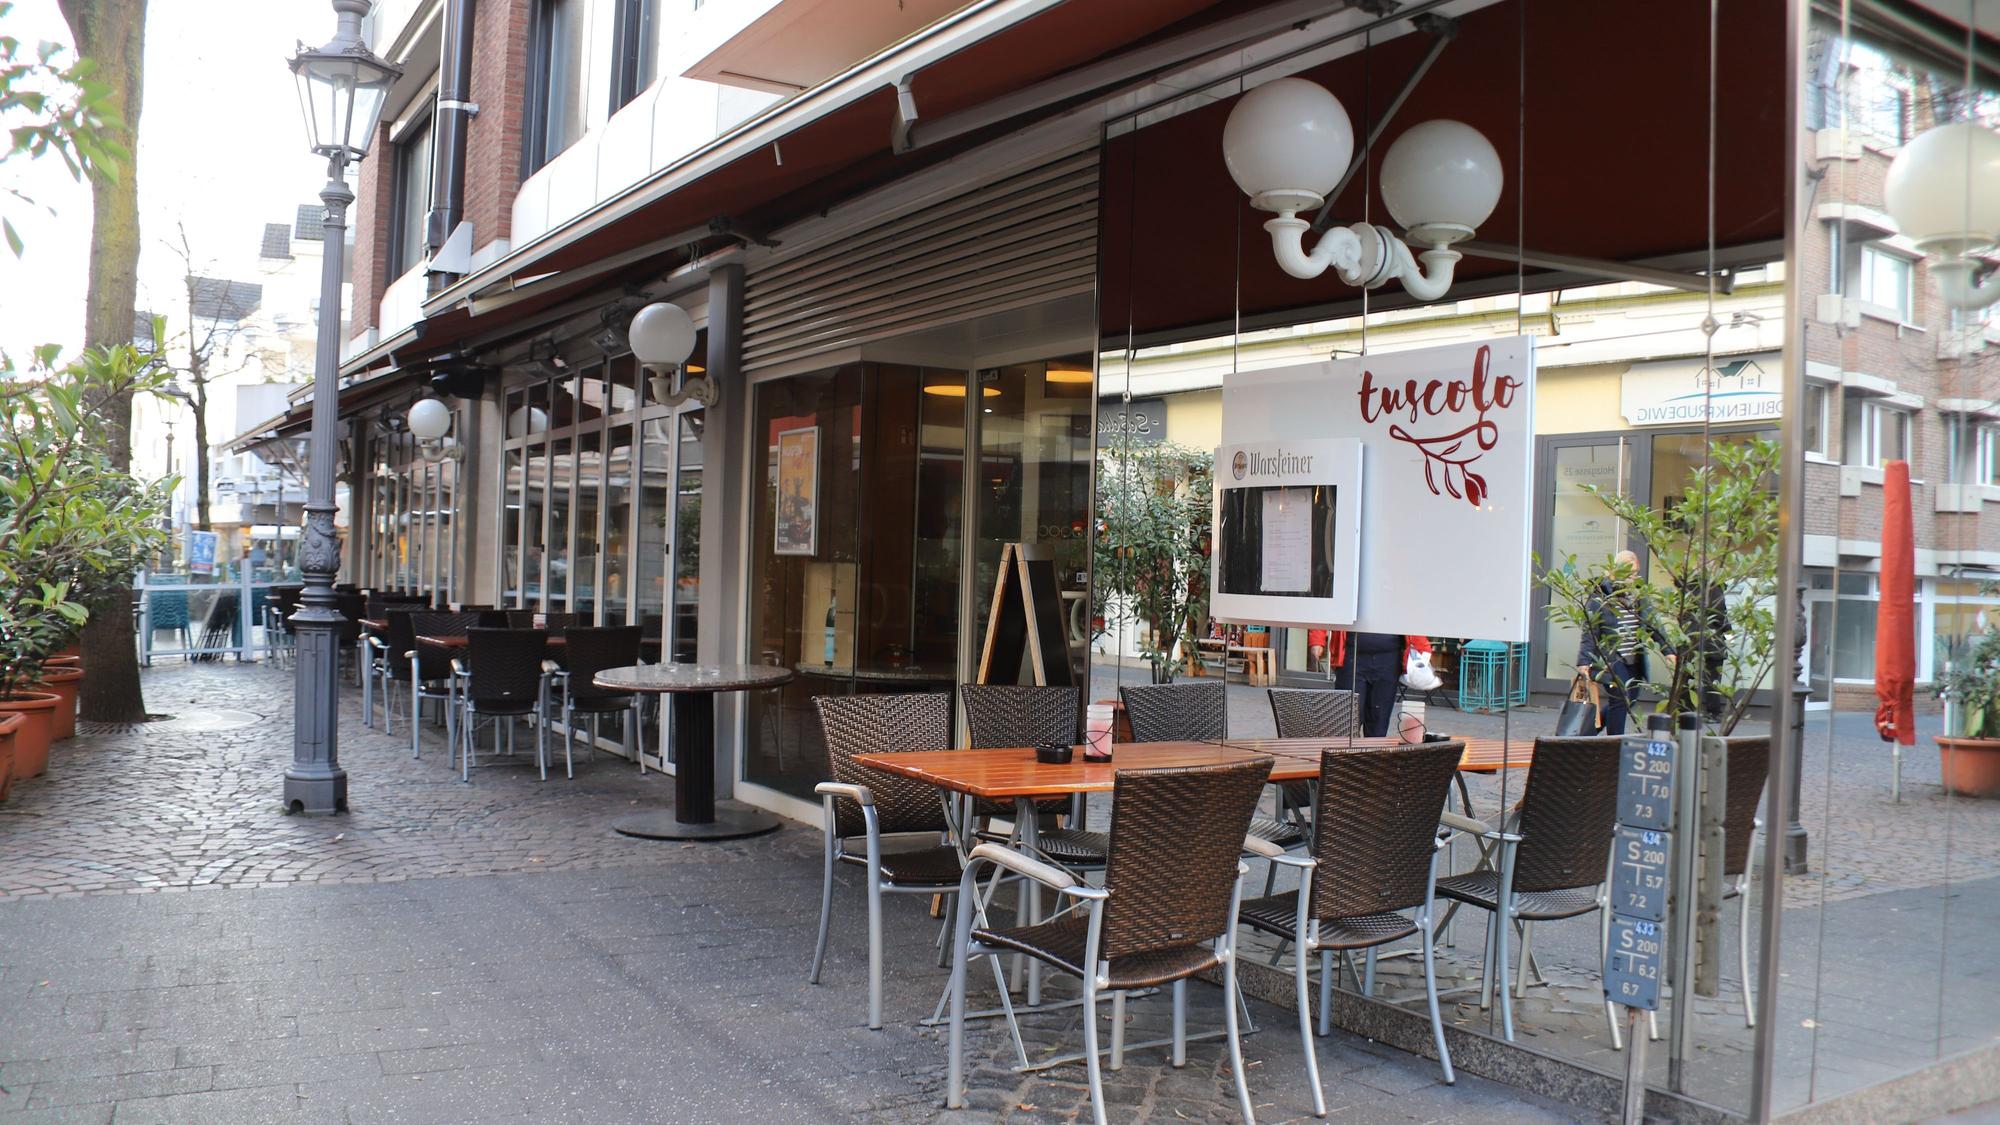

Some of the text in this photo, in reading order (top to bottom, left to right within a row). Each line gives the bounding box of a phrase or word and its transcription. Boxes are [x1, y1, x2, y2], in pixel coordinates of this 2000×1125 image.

[1357, 345, 1524, 424] tuscolo
[1250, 448, 1313, 478] Warsteiner
[1648, 742, 1667, 756] 432
[1633, 752, 1671, 774] S 200
[1651, 785, 1669, 799] 7.0
[1635, 804, 1653, 818] 7.3
[1642, 831, 1661, 846] 434
[1628, 841, 1665, 865] S 200
[1629, 893, 1647, 908] 7.2
[1635, 921, 1655, 936] 433
[1621, 929, 1658, 954] S 200
[1639, 964, 1656, 980] 6.2
[1622, 982, 1639, 996] 6.7
